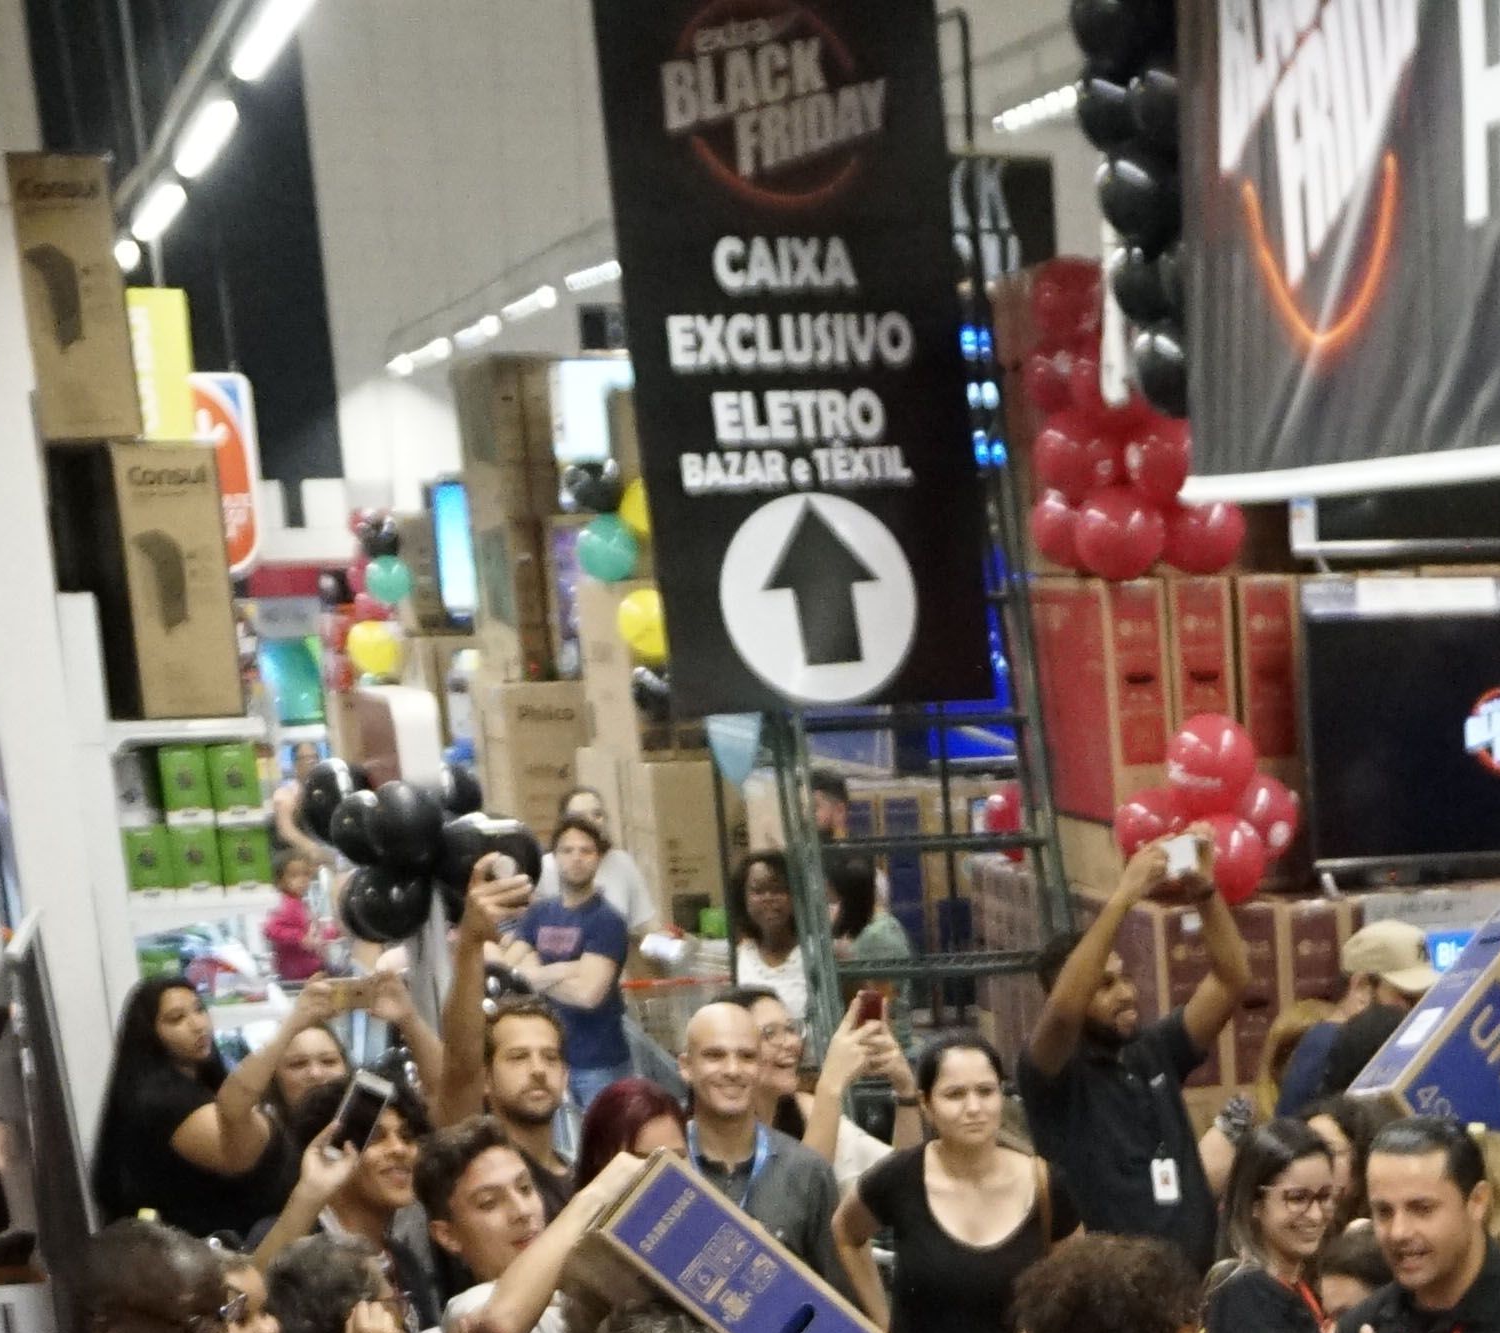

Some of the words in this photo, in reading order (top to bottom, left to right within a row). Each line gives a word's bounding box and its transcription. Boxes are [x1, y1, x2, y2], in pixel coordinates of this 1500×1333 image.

[661, 37, 828, 133] BLACK
[735, 77, 887, 179] FRIDAY
[713, 235, 859, 297] CAIXA
[666, 311, 915, 374] EXCLUSIVO
[711, 387, 886, 446] ELETRO
[126, 464, 208, 487] Consul
[679, 446, 791, 495] BAZAR
[792, 458, 813, 485] e
[813, 440, 915, 488] TÊXTIL
[638, 1187, 698, 1255] SAMSUNG
